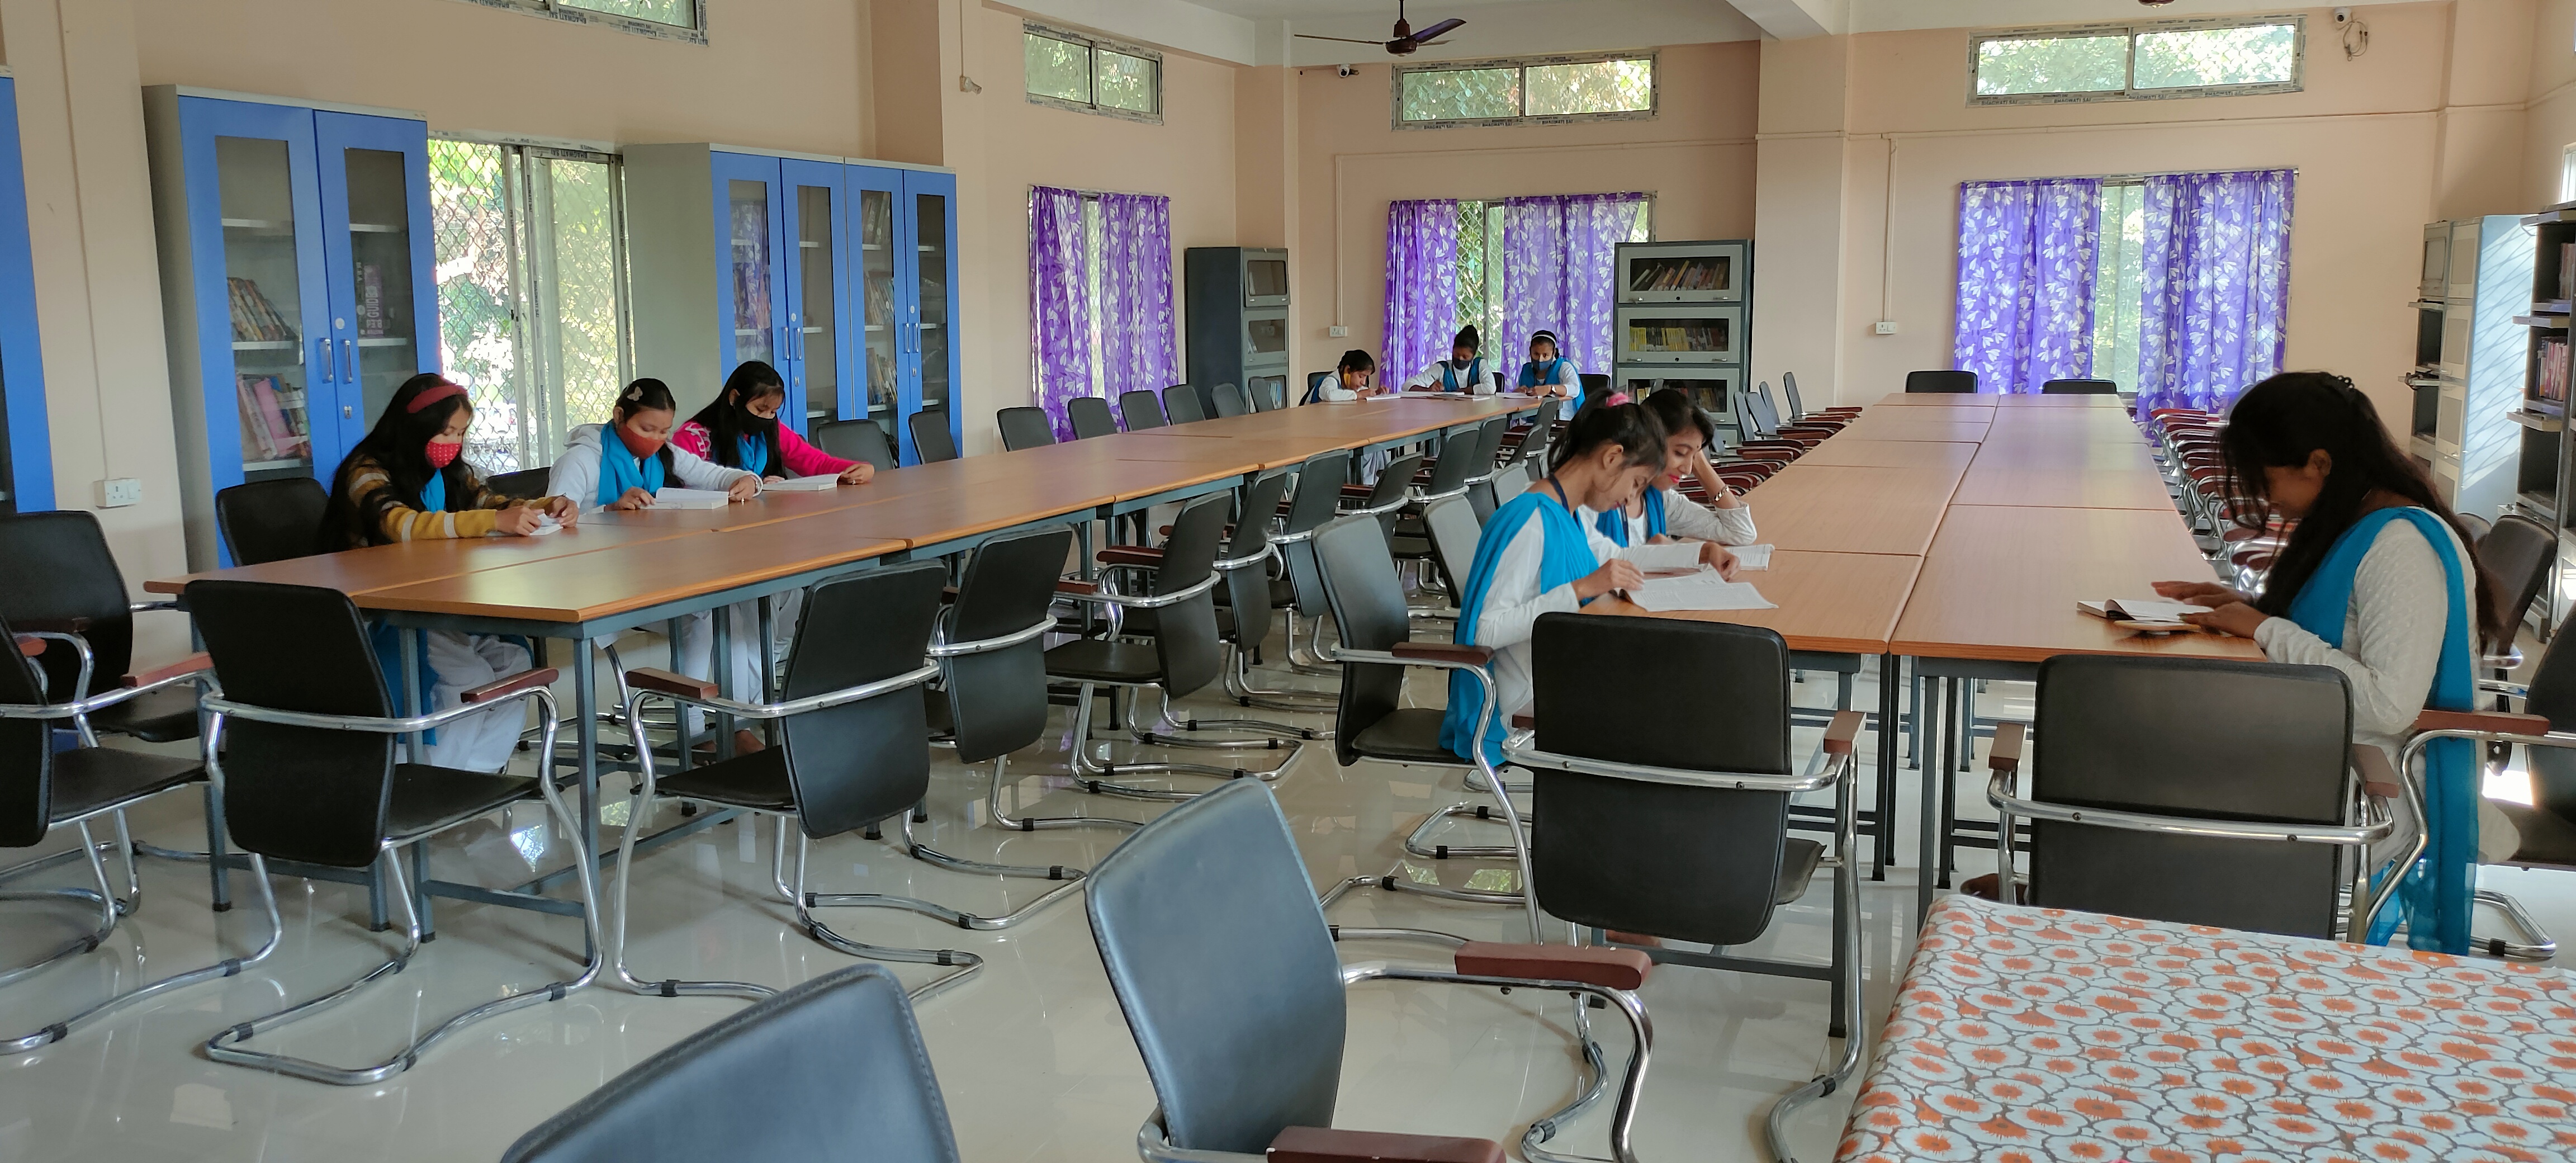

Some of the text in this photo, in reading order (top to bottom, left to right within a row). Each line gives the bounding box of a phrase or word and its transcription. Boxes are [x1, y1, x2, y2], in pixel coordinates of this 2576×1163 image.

[560, 13, 587, 24] BHAGWATI
[551, 148, 588, 159] BHAGWATI SAI
